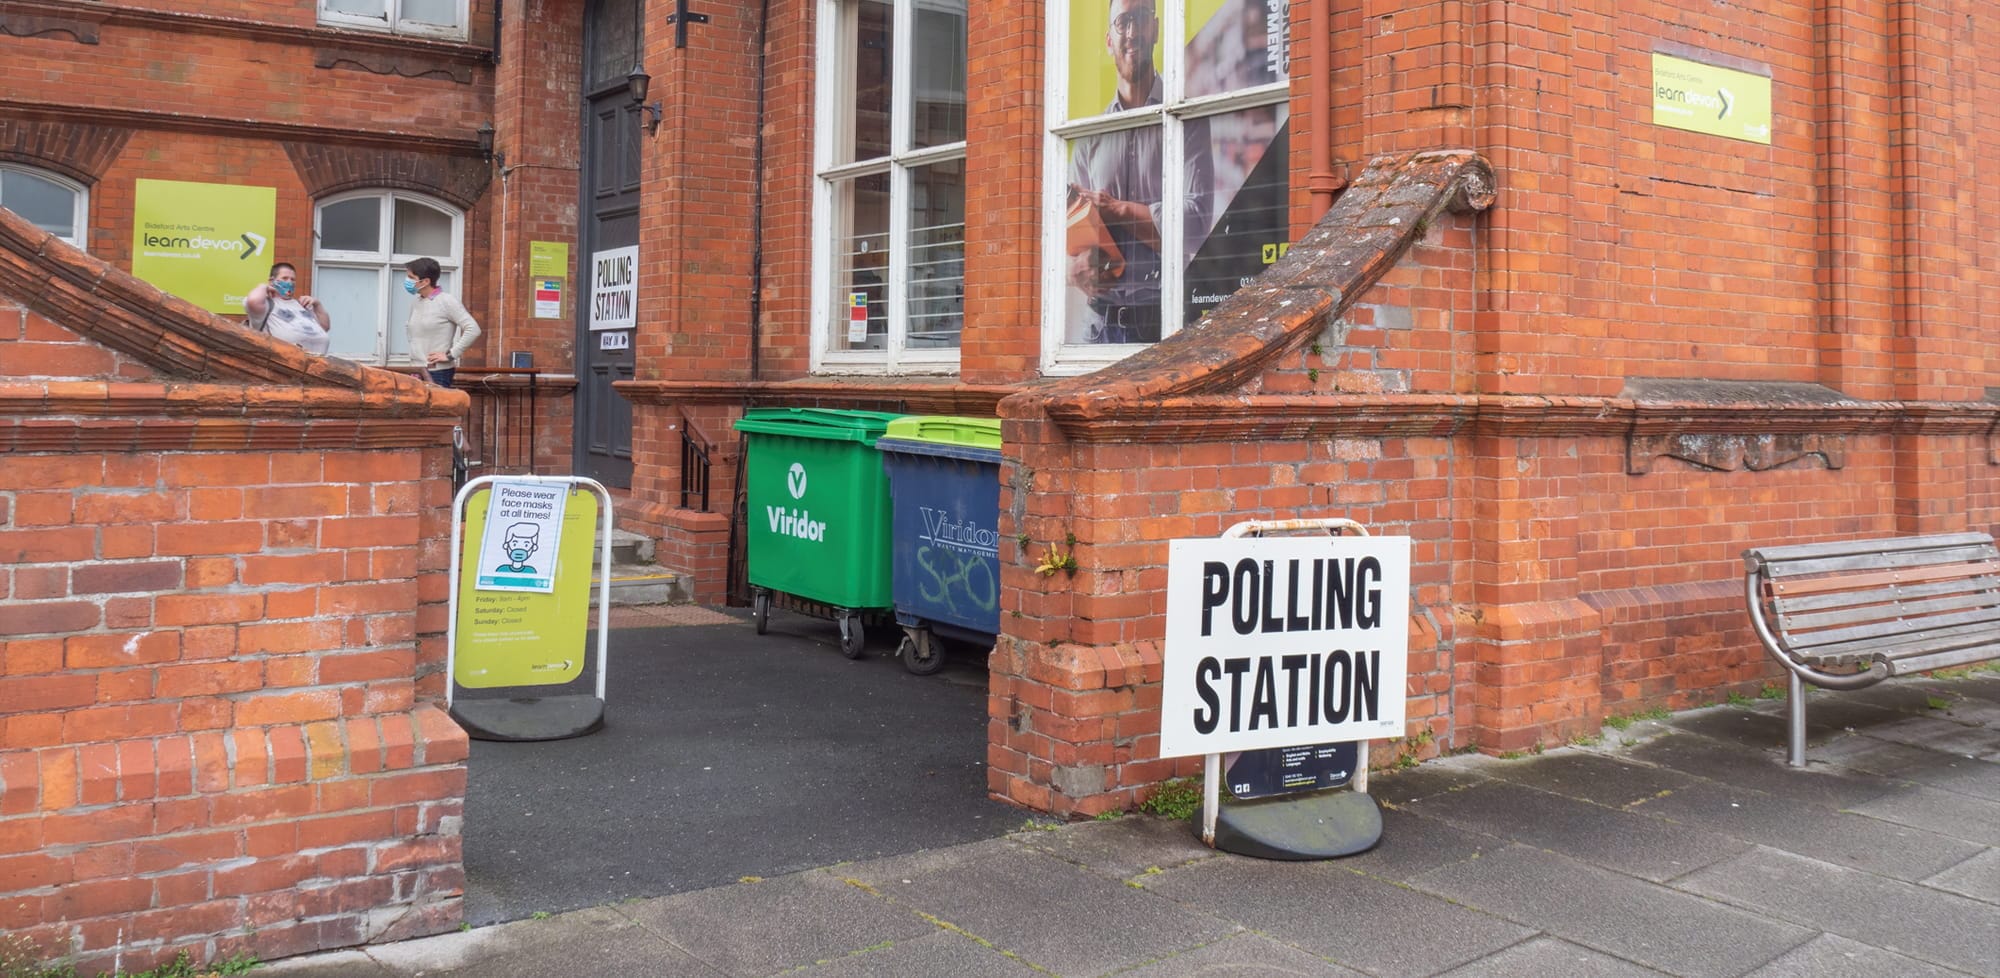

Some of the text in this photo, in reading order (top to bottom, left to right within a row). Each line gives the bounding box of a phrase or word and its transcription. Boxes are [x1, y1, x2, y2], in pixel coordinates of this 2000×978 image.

[1655, 81, 1720, 109] learndevon
[143, 232, 243, 251] learndevon
[597, 255, 632, 289] POLLING
[595, 290, 631, 321] STATION
[501, 487, 557, 500] Please wear
[501, 499, 553, 510] face masks
[500, 509, 551, 520] at all times!
[766, 505, 826, 543] Viridor
[1201, 556, 1382, 637] POLLING
[1193, 649, 1380, 735] STATION
